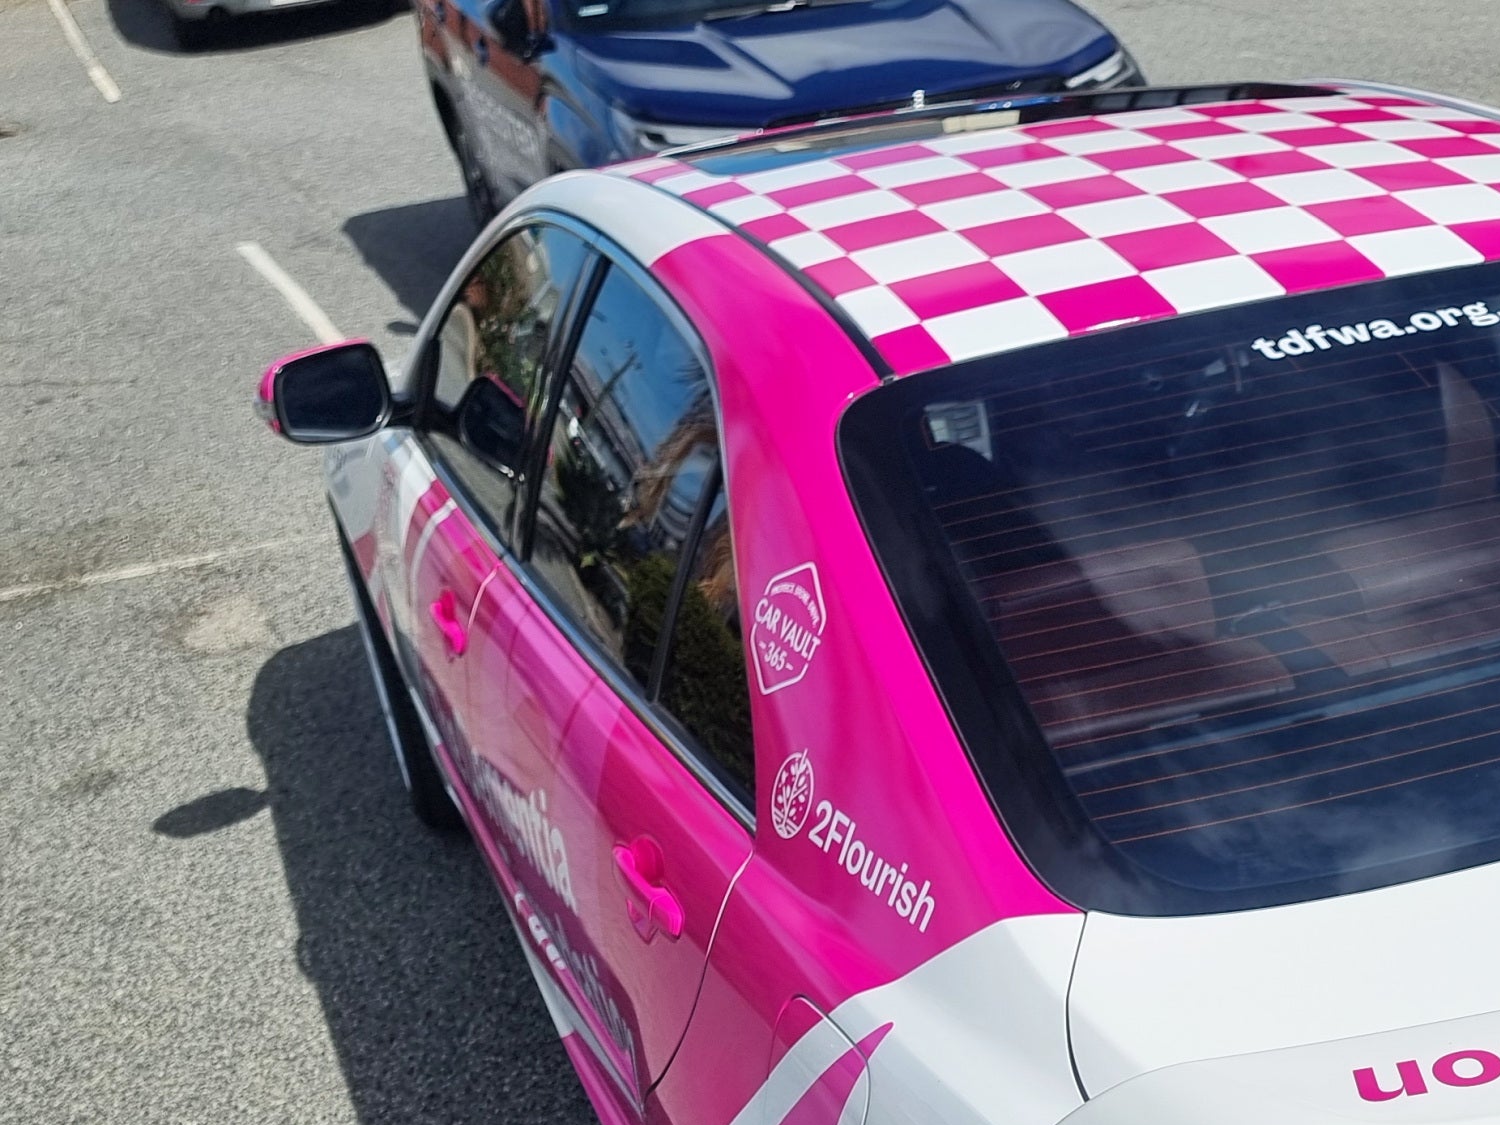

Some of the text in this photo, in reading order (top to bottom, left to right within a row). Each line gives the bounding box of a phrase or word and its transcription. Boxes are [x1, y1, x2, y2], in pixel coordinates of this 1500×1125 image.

[755, 597, 782, 634] CAR
[779, 614, 821, 661] VAULT
[808, 800, 935, 934] 2Flourish
